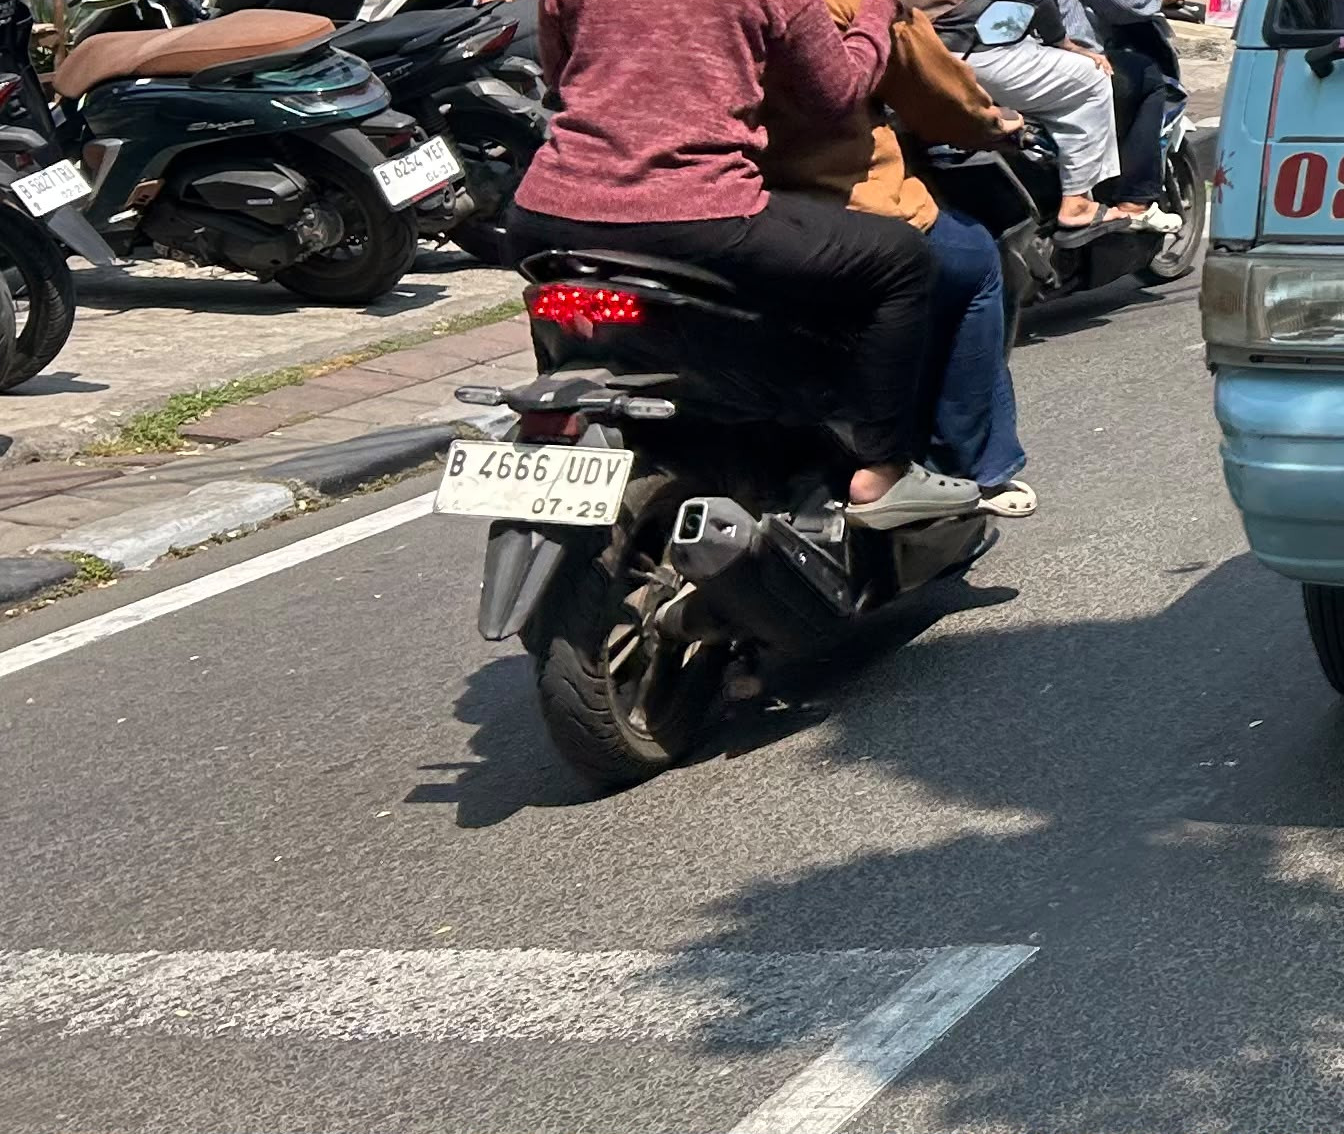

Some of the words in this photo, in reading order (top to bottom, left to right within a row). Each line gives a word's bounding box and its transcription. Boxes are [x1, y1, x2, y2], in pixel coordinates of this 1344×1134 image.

[379, 170, 391, 186] B
[17, 184, 33, 200] B
[449, 449, 468, 477] B
[478, 450, 551, 482] 4666
[566, 455, 622, 486] UDV
